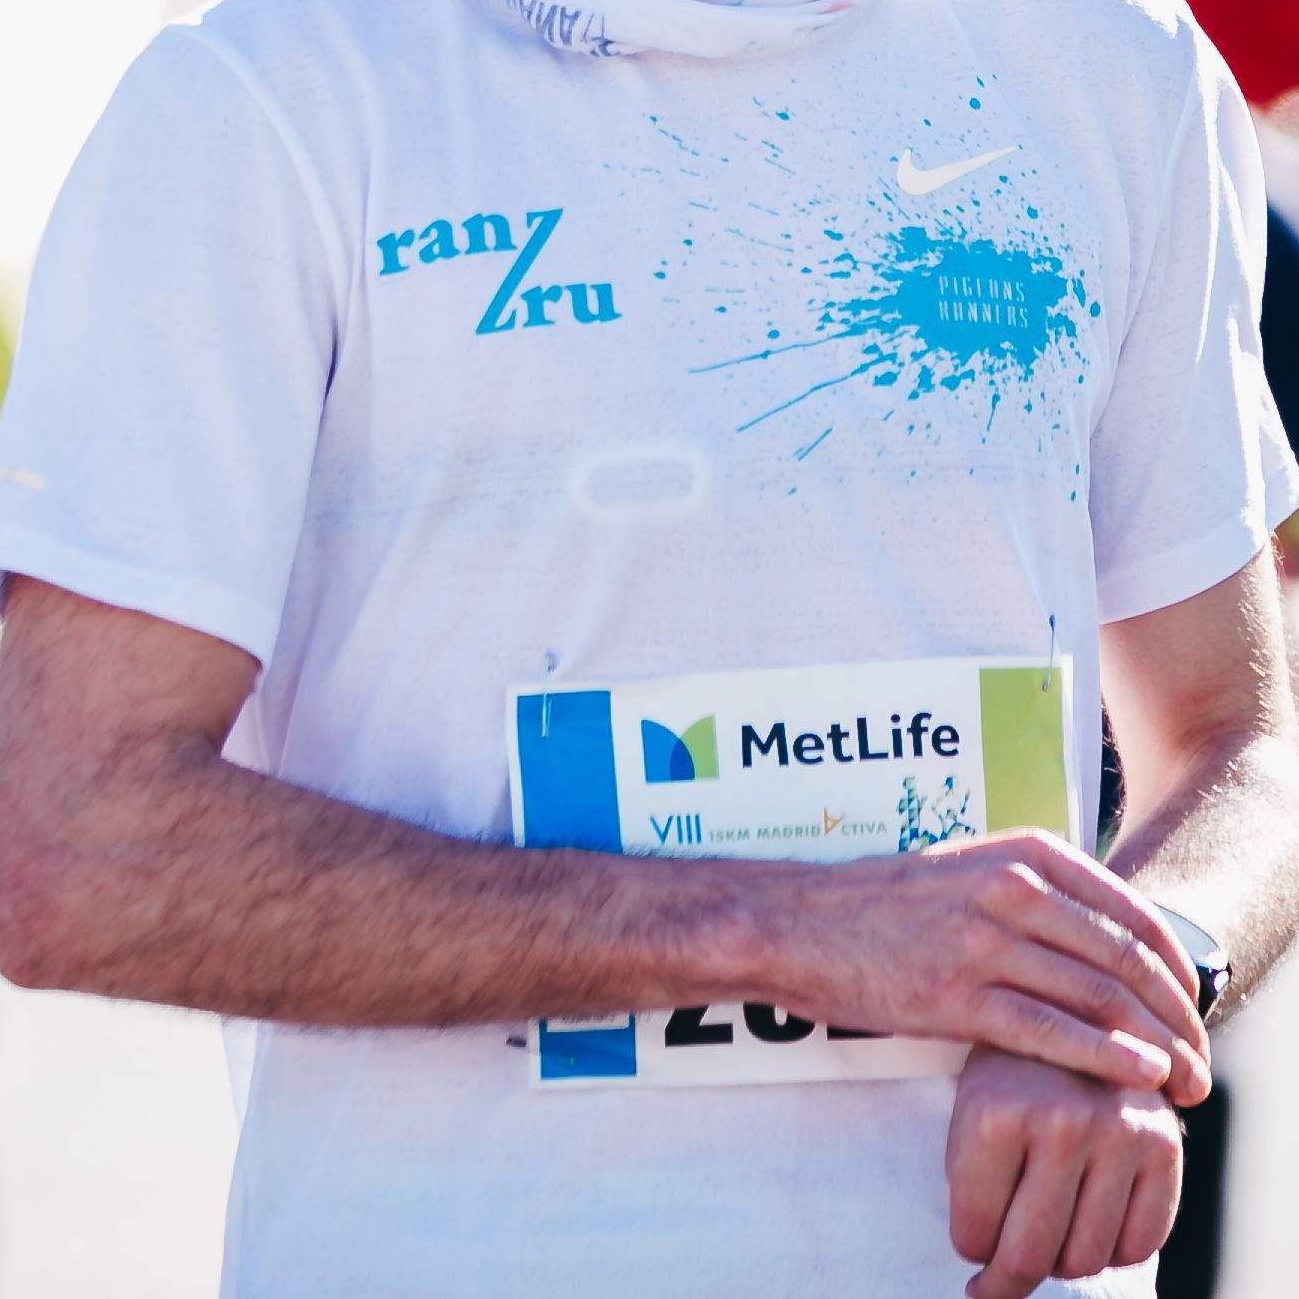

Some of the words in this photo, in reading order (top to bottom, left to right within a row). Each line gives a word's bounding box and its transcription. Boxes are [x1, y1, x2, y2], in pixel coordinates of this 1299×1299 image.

[741, 711, 960, 769] MetLife
[649, 812, 702, 845] VIII
[709, 827, 751, 844] 15KM
[755, 821, 821, 841] MADRID
